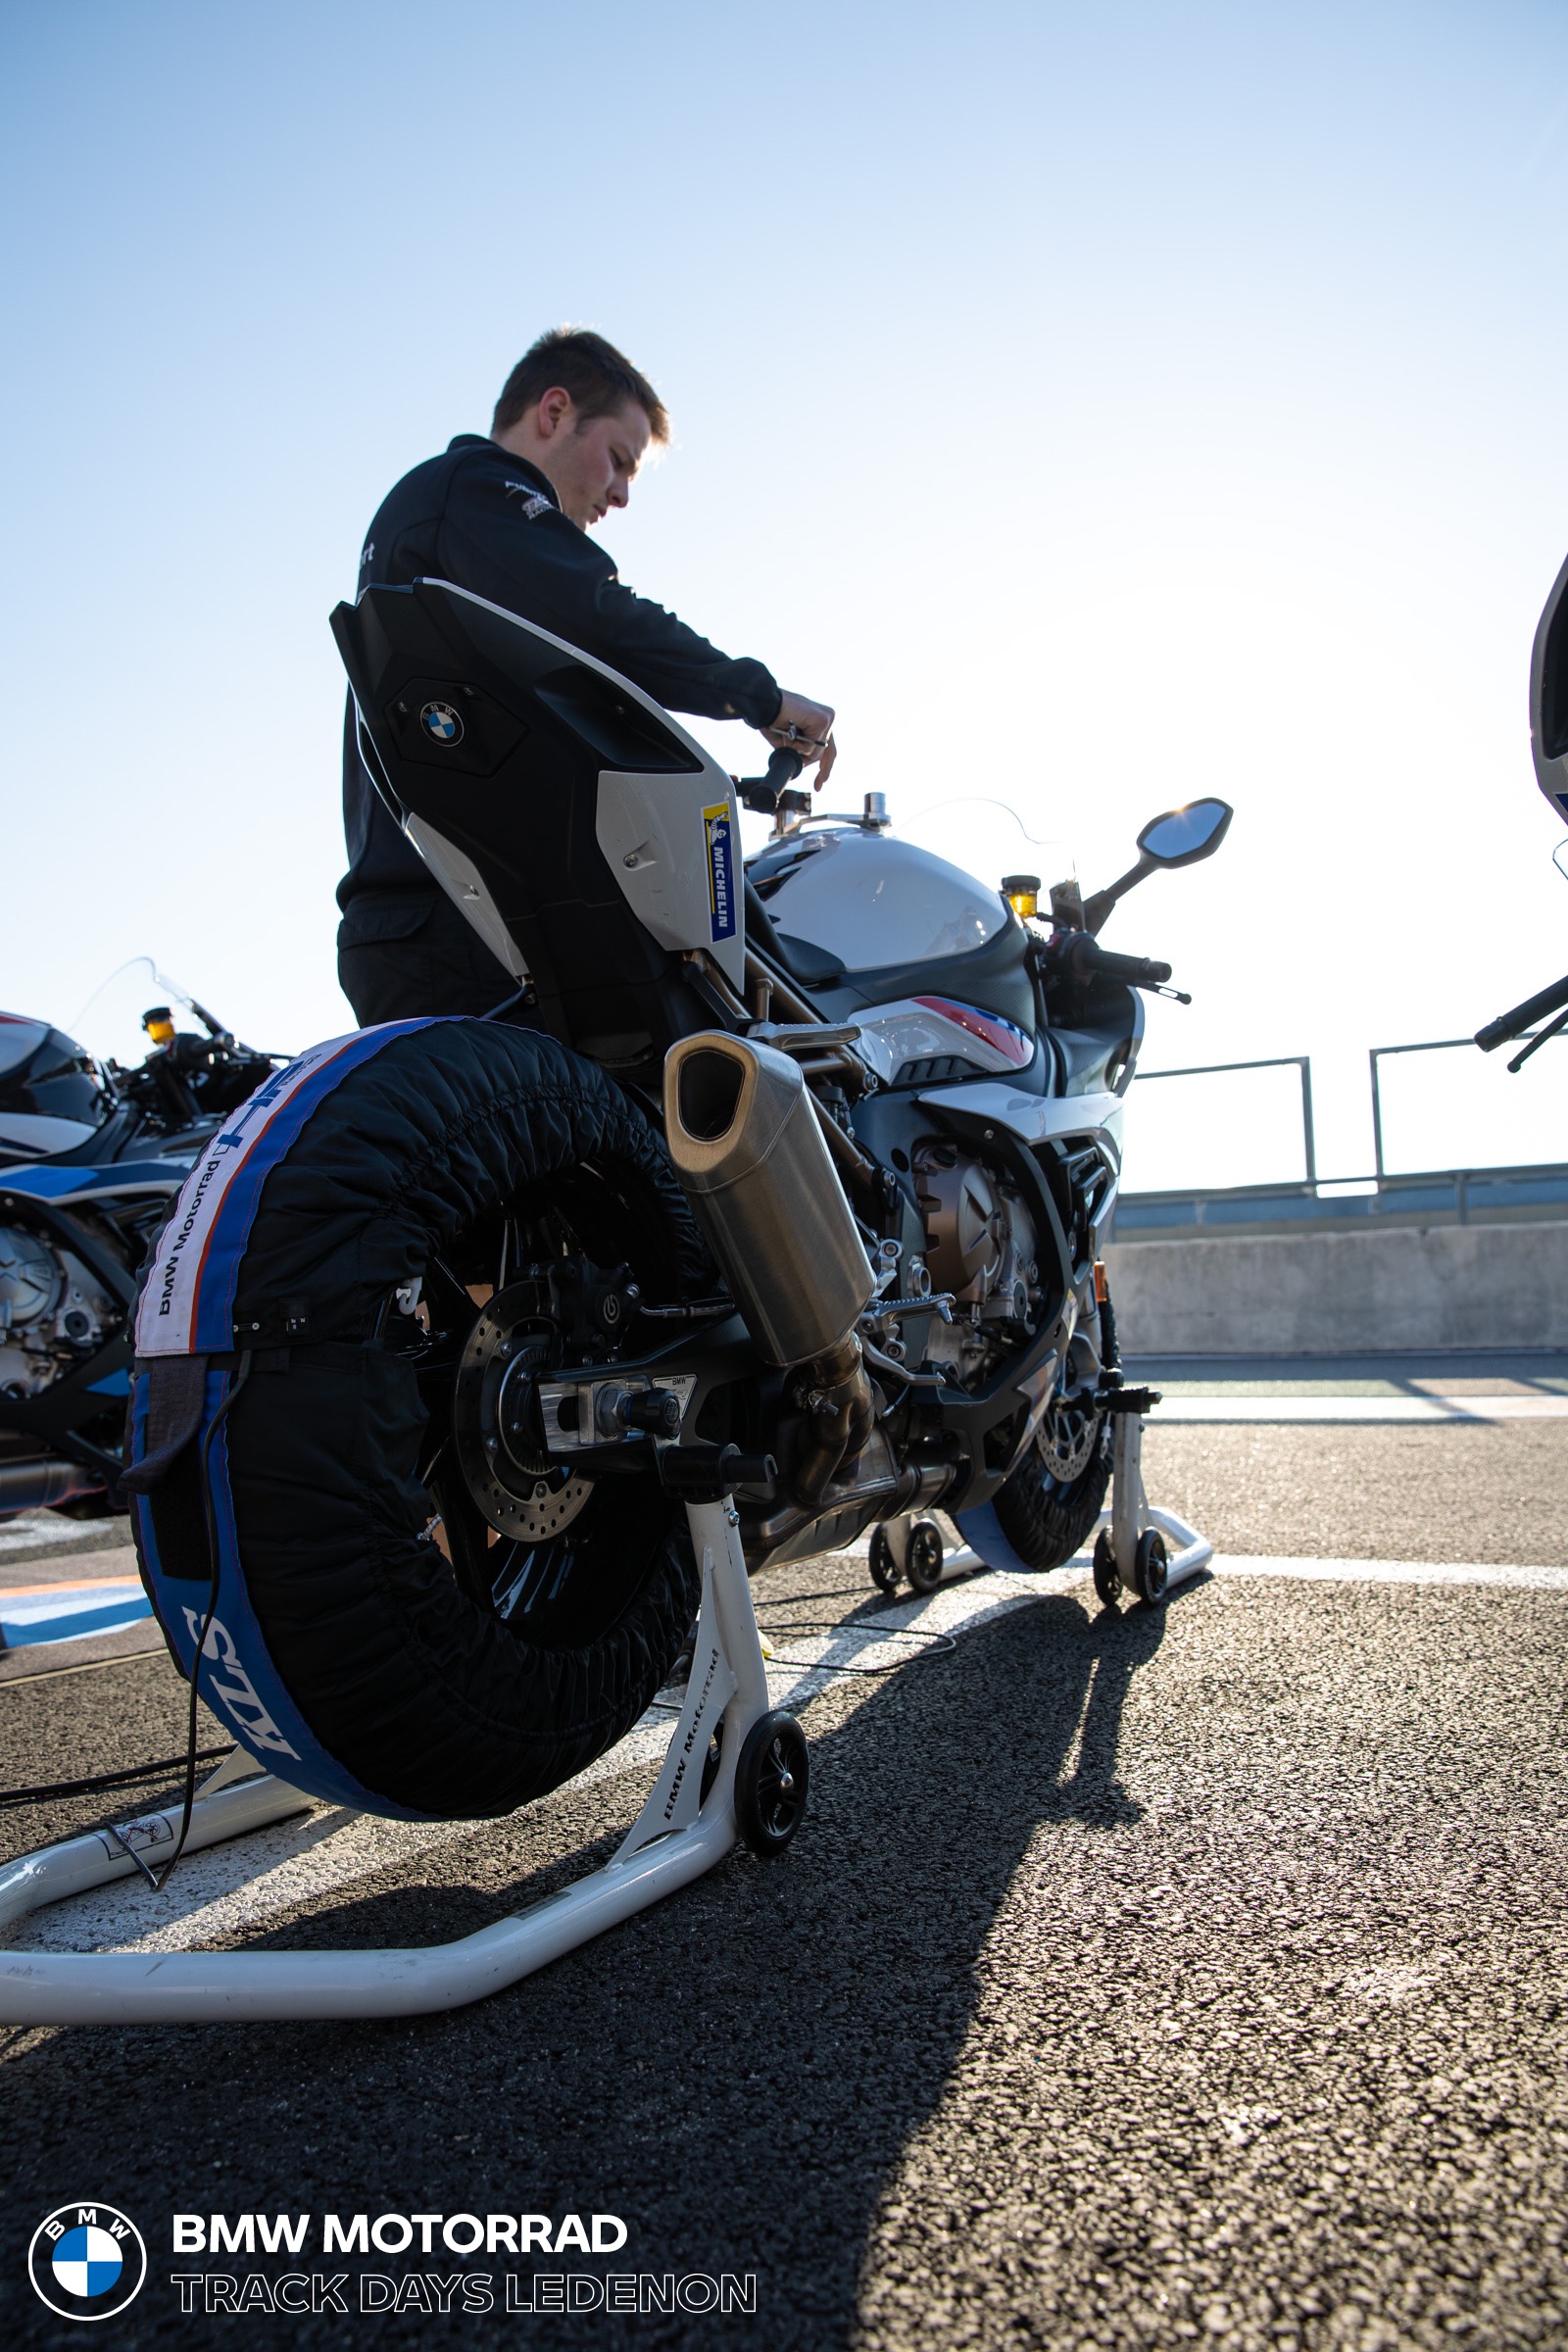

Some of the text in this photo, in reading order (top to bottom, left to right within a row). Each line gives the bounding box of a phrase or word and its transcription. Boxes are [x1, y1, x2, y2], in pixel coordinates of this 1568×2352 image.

[422, 704, 454, 721] BMW
[713, 846, 728, 928] MICHELIN
[159, 1256, 179, 1316] BMW
[172, 1160, 221, 1252] Motorrad
[672, 1376, 686, 1386] BMW
[181, 1605, 303, 1761] KLS
[663, 1647, 720, 1821] BMW Motorrad
